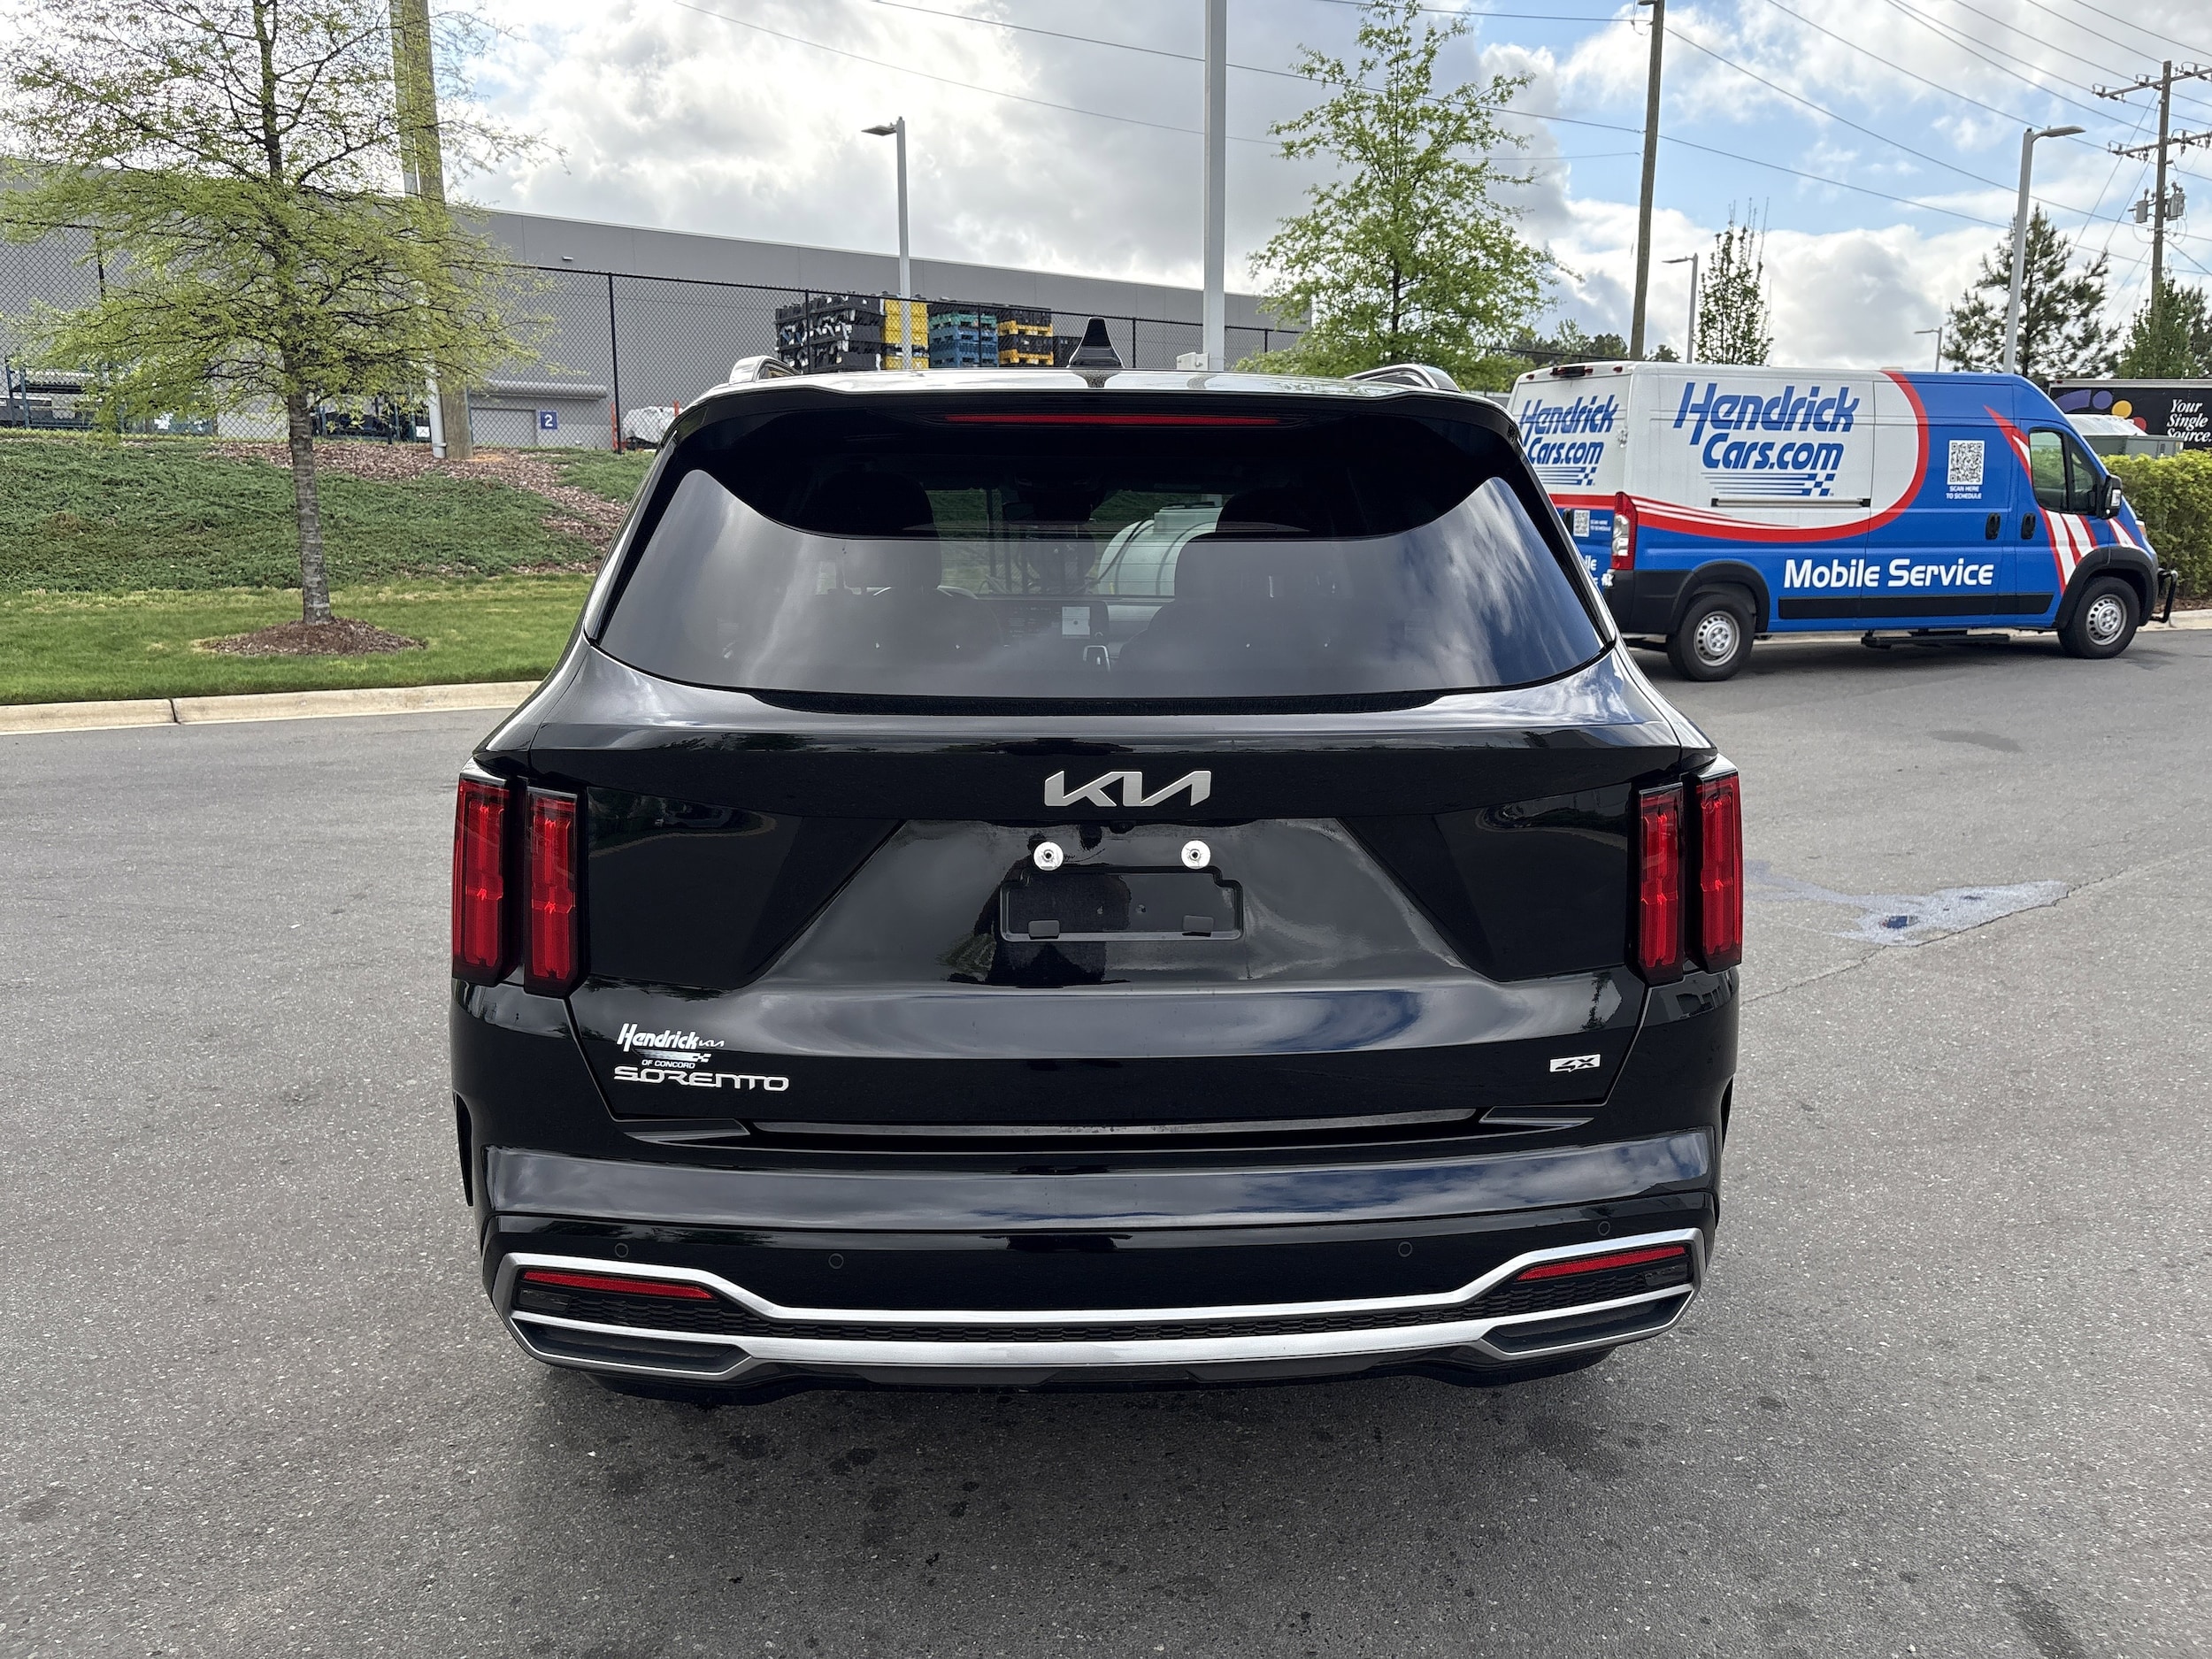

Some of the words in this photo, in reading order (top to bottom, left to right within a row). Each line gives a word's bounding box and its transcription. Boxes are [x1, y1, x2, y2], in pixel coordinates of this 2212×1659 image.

[544, 414, 554, 426] 2
[1673, 382, 1860, 445] Hendrick
[2170, 399, 2203, 413] Your
[1519, 395, 1619, 447] Hendrick
[2167, 413, 2208, 431] Single
[1527, 436, 1604, 465] Cars.com
[1703, 433, 1844, 470] Cars.com
[1784, 558, 1879, 588] Mobile
[1887, 558, 1993, 588] Service
[1044, 771, 1211, 807] KIA
[617, 1023, 700, 1052] Hendrick
[614, 1066, 789, 1092] SORENTO
[654, 1060, 695, 1069] CONCORD
